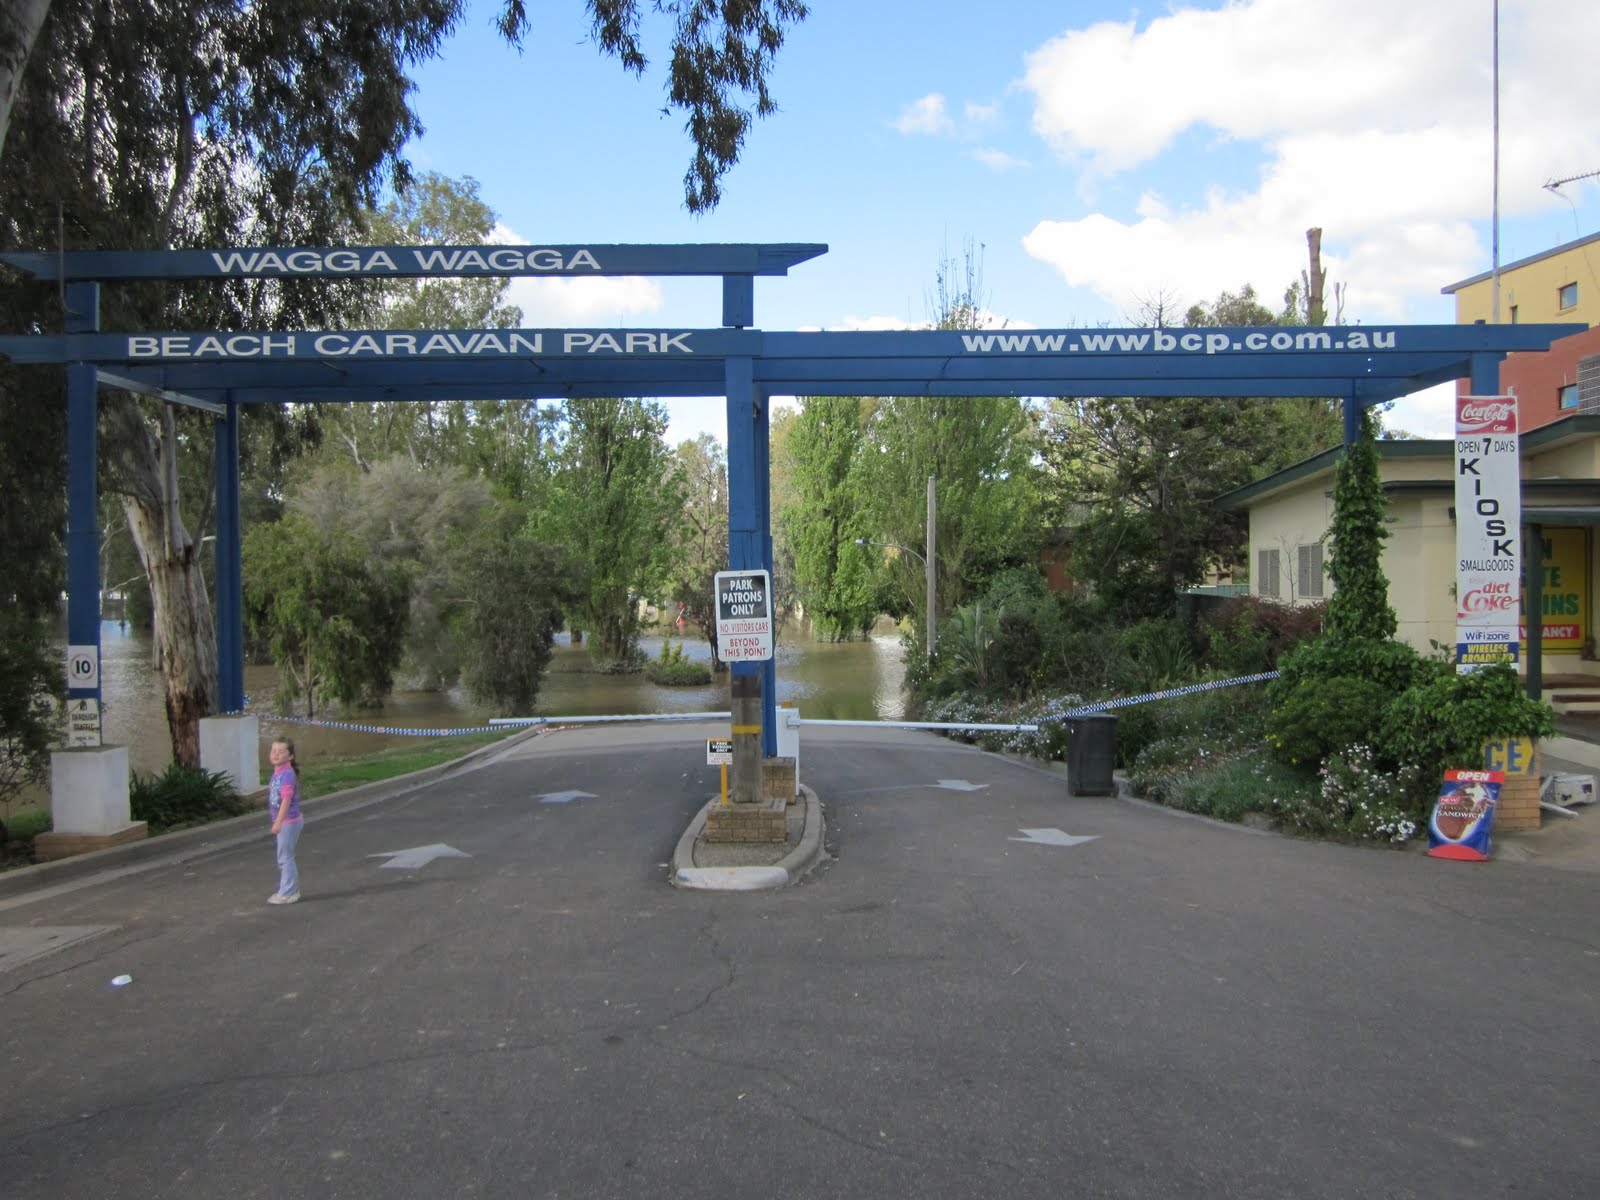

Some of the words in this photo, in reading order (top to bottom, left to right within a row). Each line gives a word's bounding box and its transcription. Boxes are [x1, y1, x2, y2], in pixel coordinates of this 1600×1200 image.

[211, 250, 398, 273] WAGGA
[413, 249, 602, 271] WAGGA
[127, 335, 296, 358] BEACH
[314, 333, 543, 356] CARAVAN
[563, 332, 694, 354] PARK
[961, 330, 1396, 354] www.wwbcp.com.au
[1458, 441, 1480, 453] OPEN
[1482, 438, 1492, 456] 7
[1494, 440, 1516, 453] DAYS
[1460, 559, 1514, 572] SMALLGOODS
[730, 579, 753, 591] PARK
[1482, 581, 1510, 594] diet
[722, 591, 762, 604] PATRONS
[1462, 589, 1519, 612] Coke
[730, 604, 755, 615] ONLY
[720, 624, 729, 633] NO
[732, 622, 754, 632] VISITORS
[755, 621, 769, 631] CARS
[729, 637, 760, 648] BEYOND
[1467, 643, 1509, 653] WIRELESS
[724, 649, 740, 657] THIS
[743, 647, 766, 657] POINT
[1461, 653, 1515, 663] BROADBND
[75, 660, 91, 674] 10
[1456, 771, 1490, 781] OPEN
[1437, 811, 1485, 819] SANDWICH
